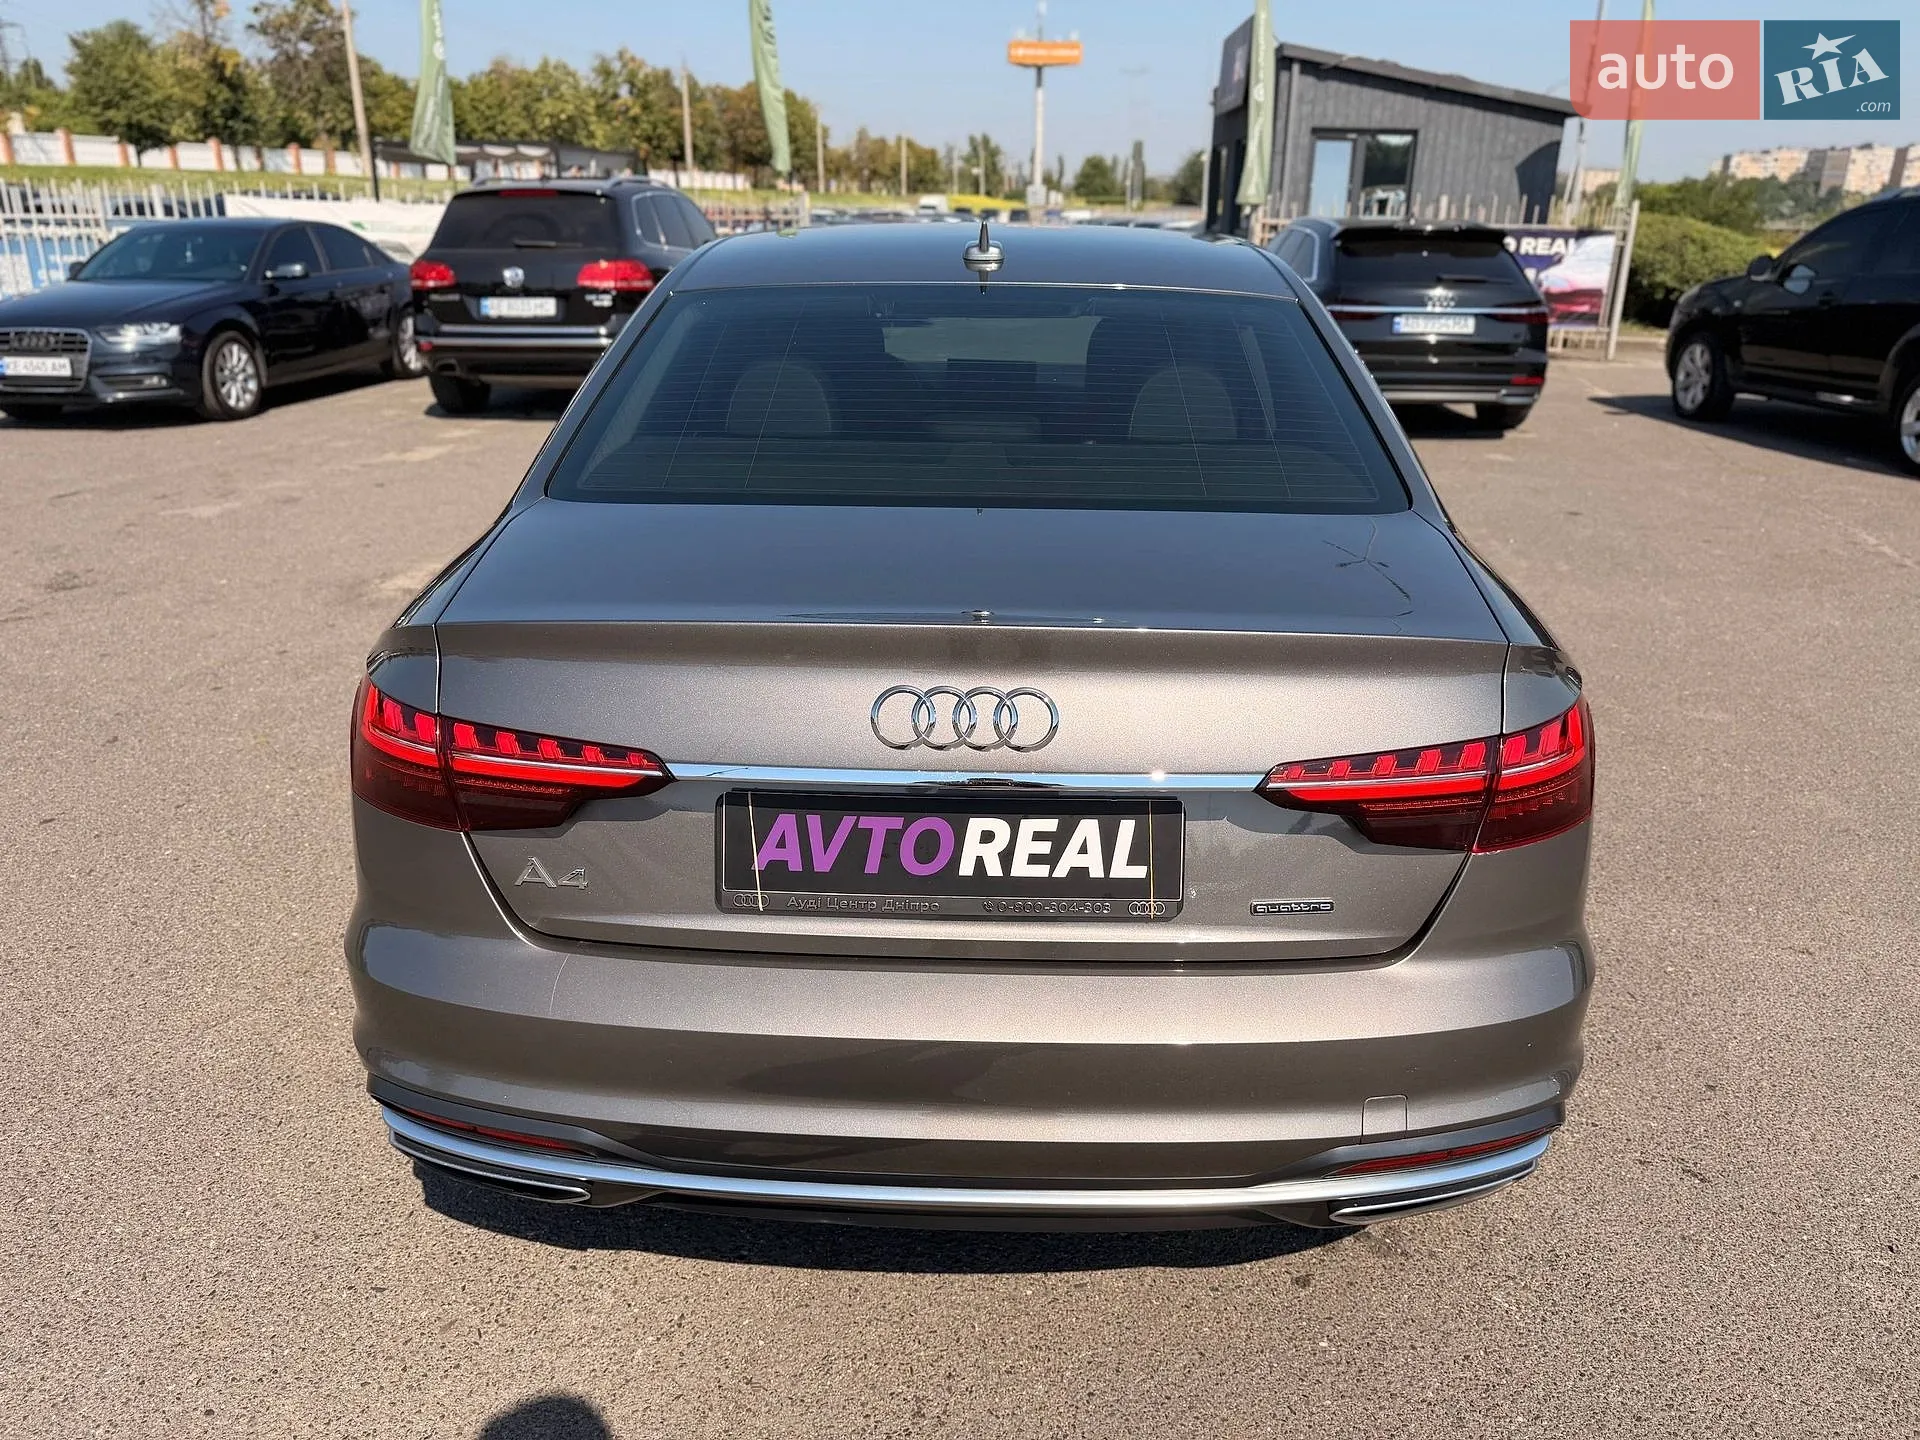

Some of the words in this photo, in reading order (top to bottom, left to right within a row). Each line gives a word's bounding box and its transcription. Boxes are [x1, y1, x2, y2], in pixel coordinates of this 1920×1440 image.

[751, 813, 1149, 879] AVTOREAL
[514, 856, 588, 890] A4
[787, 896, 822, 910] Ауді
[827, 897, 877, 910] Центр
[881, 899, 940, 912] Дніпро
[1256, 903, 1331, 914] quattro
